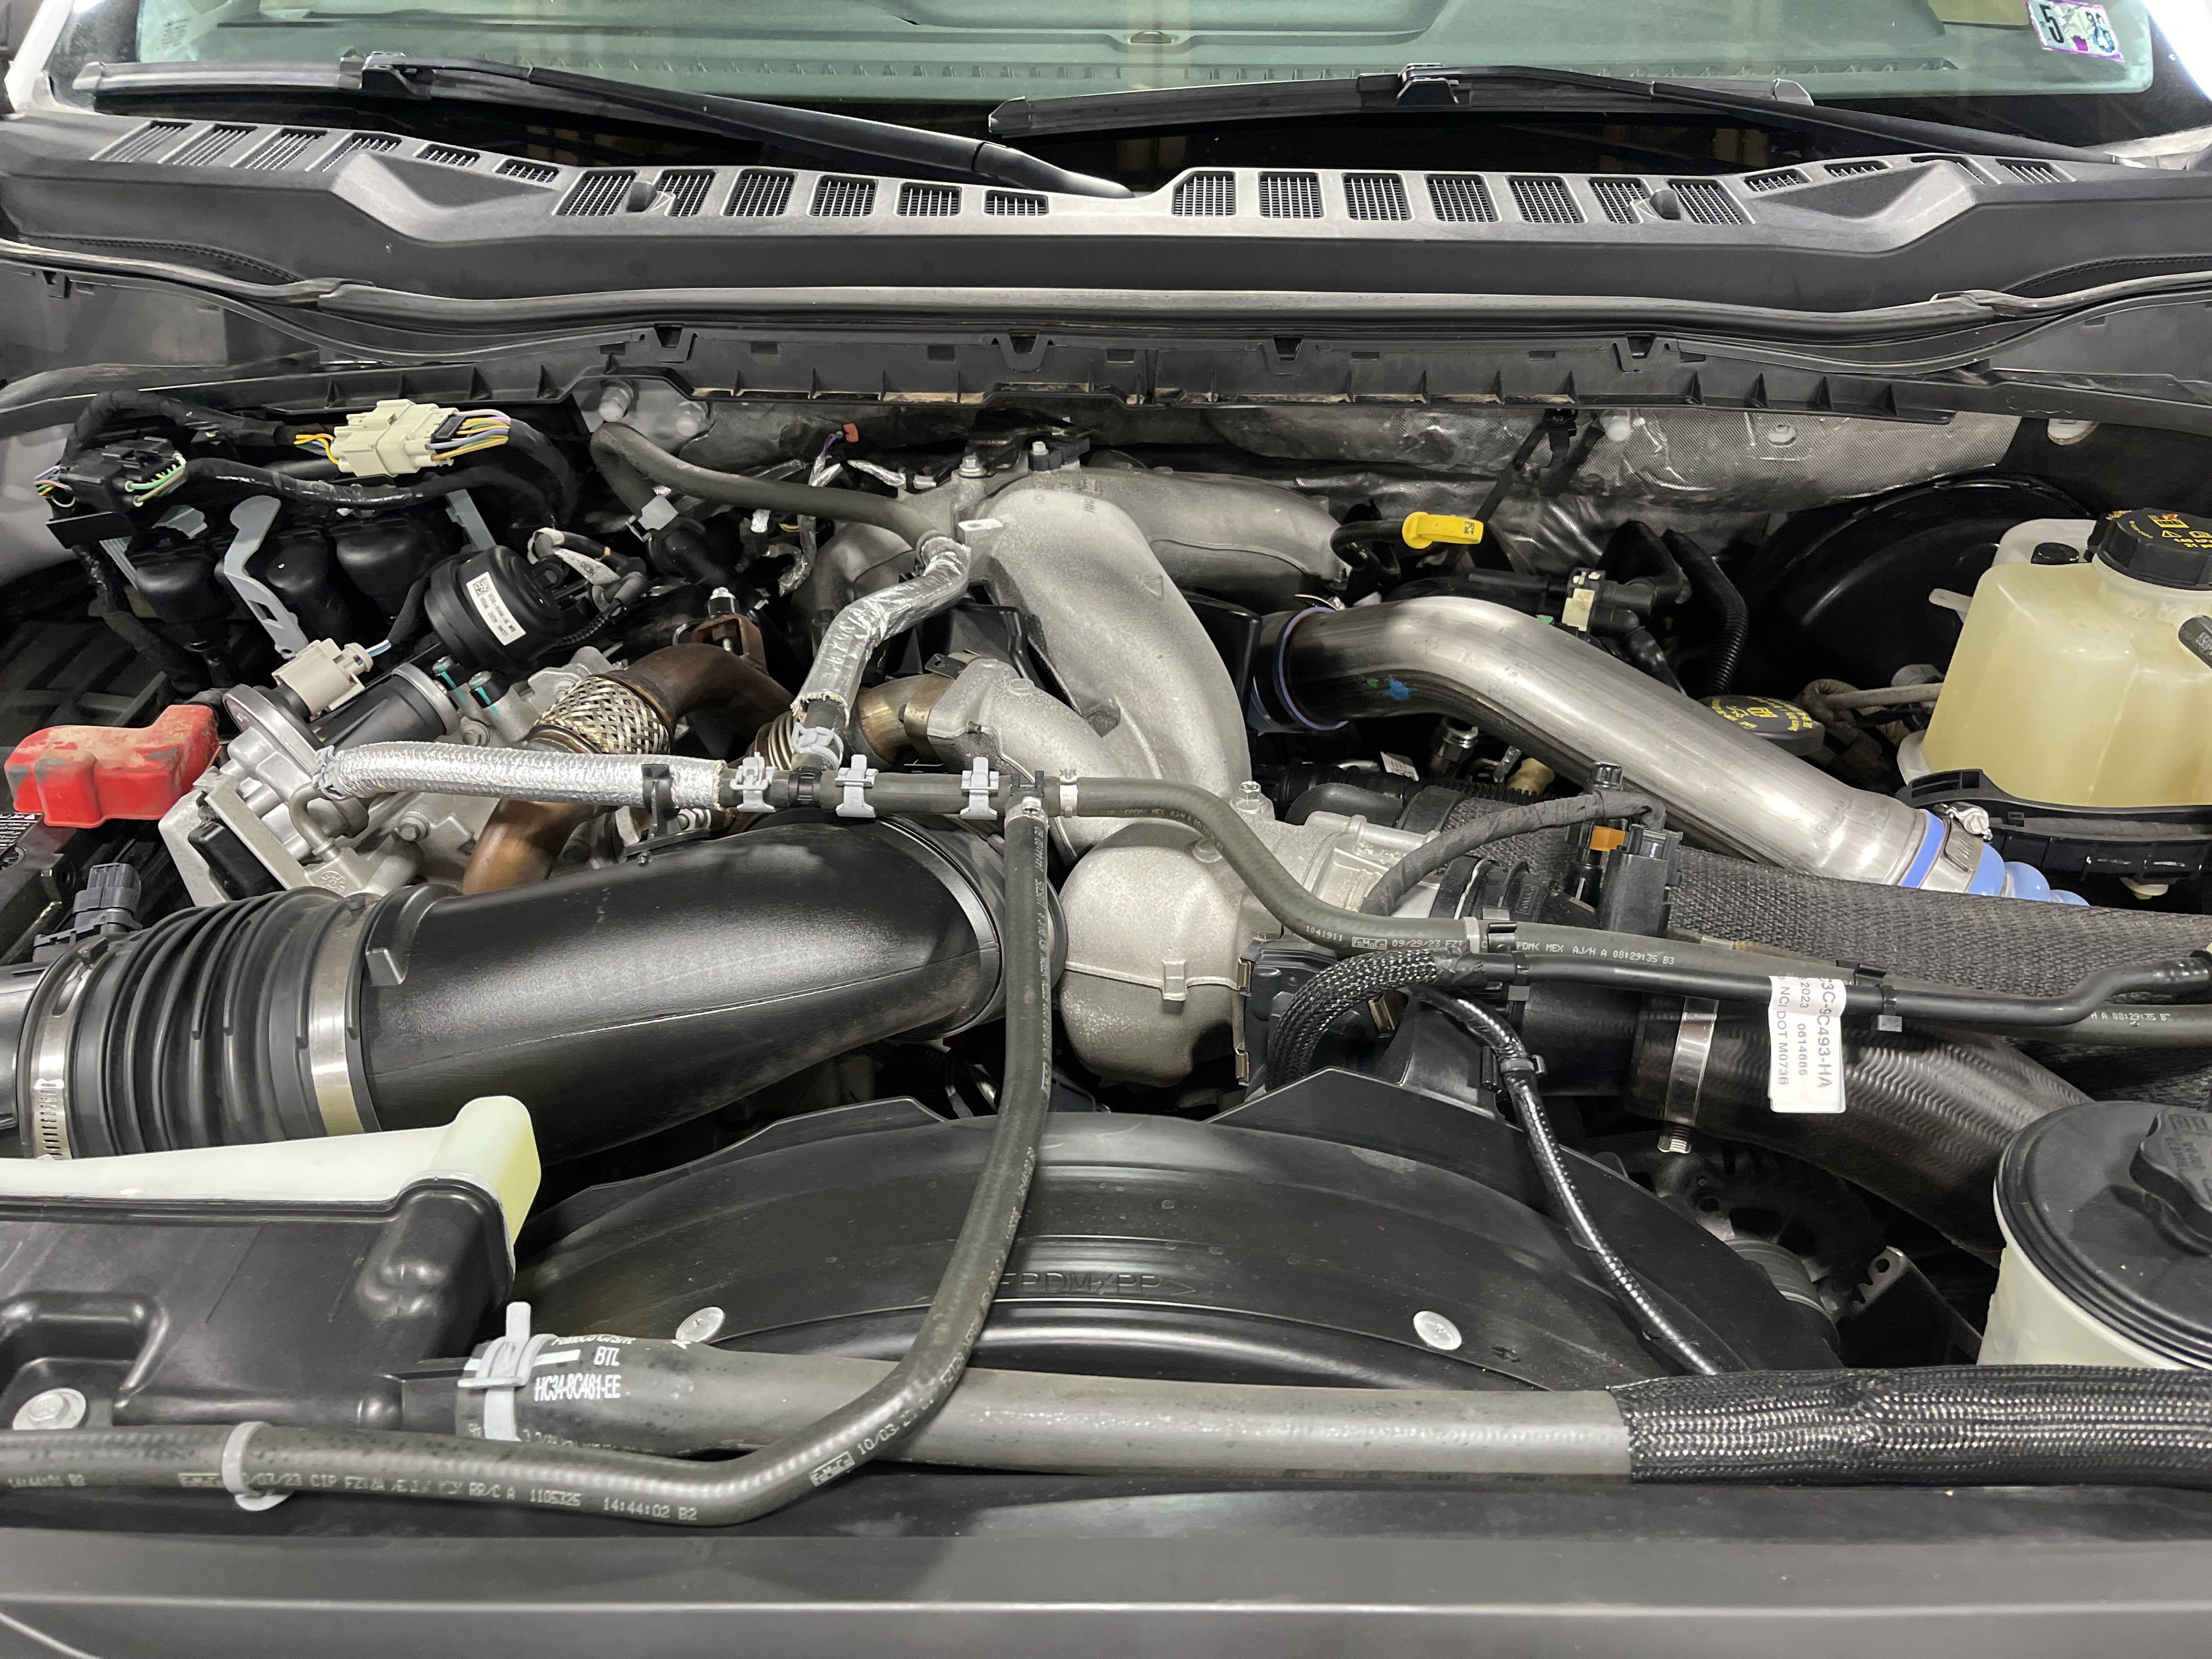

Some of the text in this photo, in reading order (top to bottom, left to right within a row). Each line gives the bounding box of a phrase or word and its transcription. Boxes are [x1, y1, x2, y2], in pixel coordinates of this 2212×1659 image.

[2039, 4, 2064, 43] 5
[1306, 925, 1342, 941] 1041911
[1392, 939, 1441, 948] 09/29/23
[1545, 944, 1564, 953] MEX
[1600, 949, 1607, 957] A
[1612, 950, 1658, 963] 08:29:35
[1663, 956, 1675, 966] B3
[593, 1345, 620, 1367] BTL
[534, 1373, 622, 1401] HC34-8C481-EE
[604, 1496, 671, 1519] 14:44:02
[678, 1506, 698, 1521] B2
